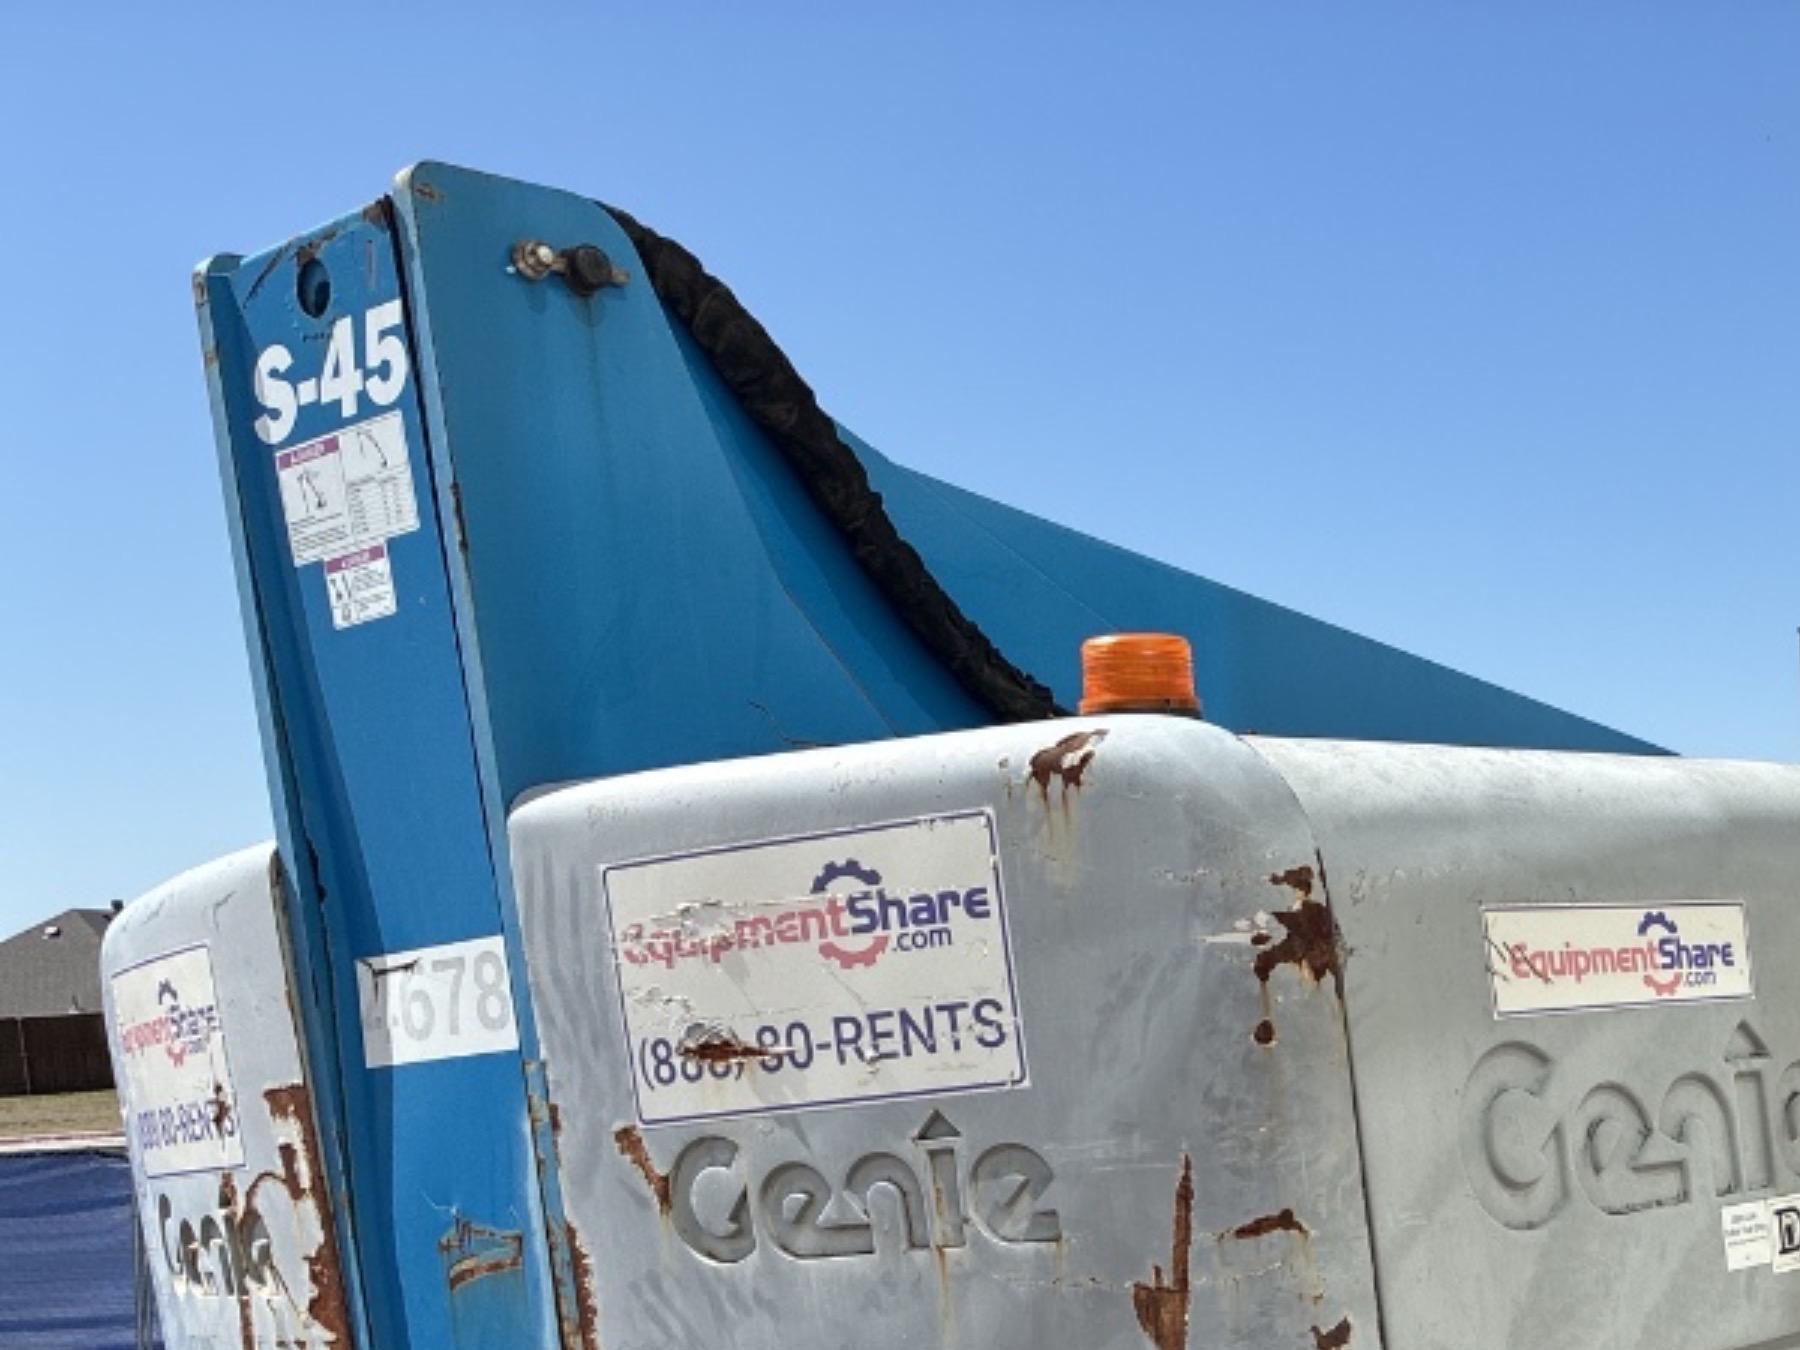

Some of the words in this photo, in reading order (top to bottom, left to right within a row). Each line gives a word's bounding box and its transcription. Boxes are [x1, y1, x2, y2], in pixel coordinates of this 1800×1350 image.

[254, 298, 407, 444] S-45
[891, 925, 953, 953] .com
[1510, 936, 1735, 985] EquipmentShare
[366, 950, 510, 1041] 678
[756, 999, 1007, 1072] 80-RENTS
[668, 1109, 1063, 1265] Genie
